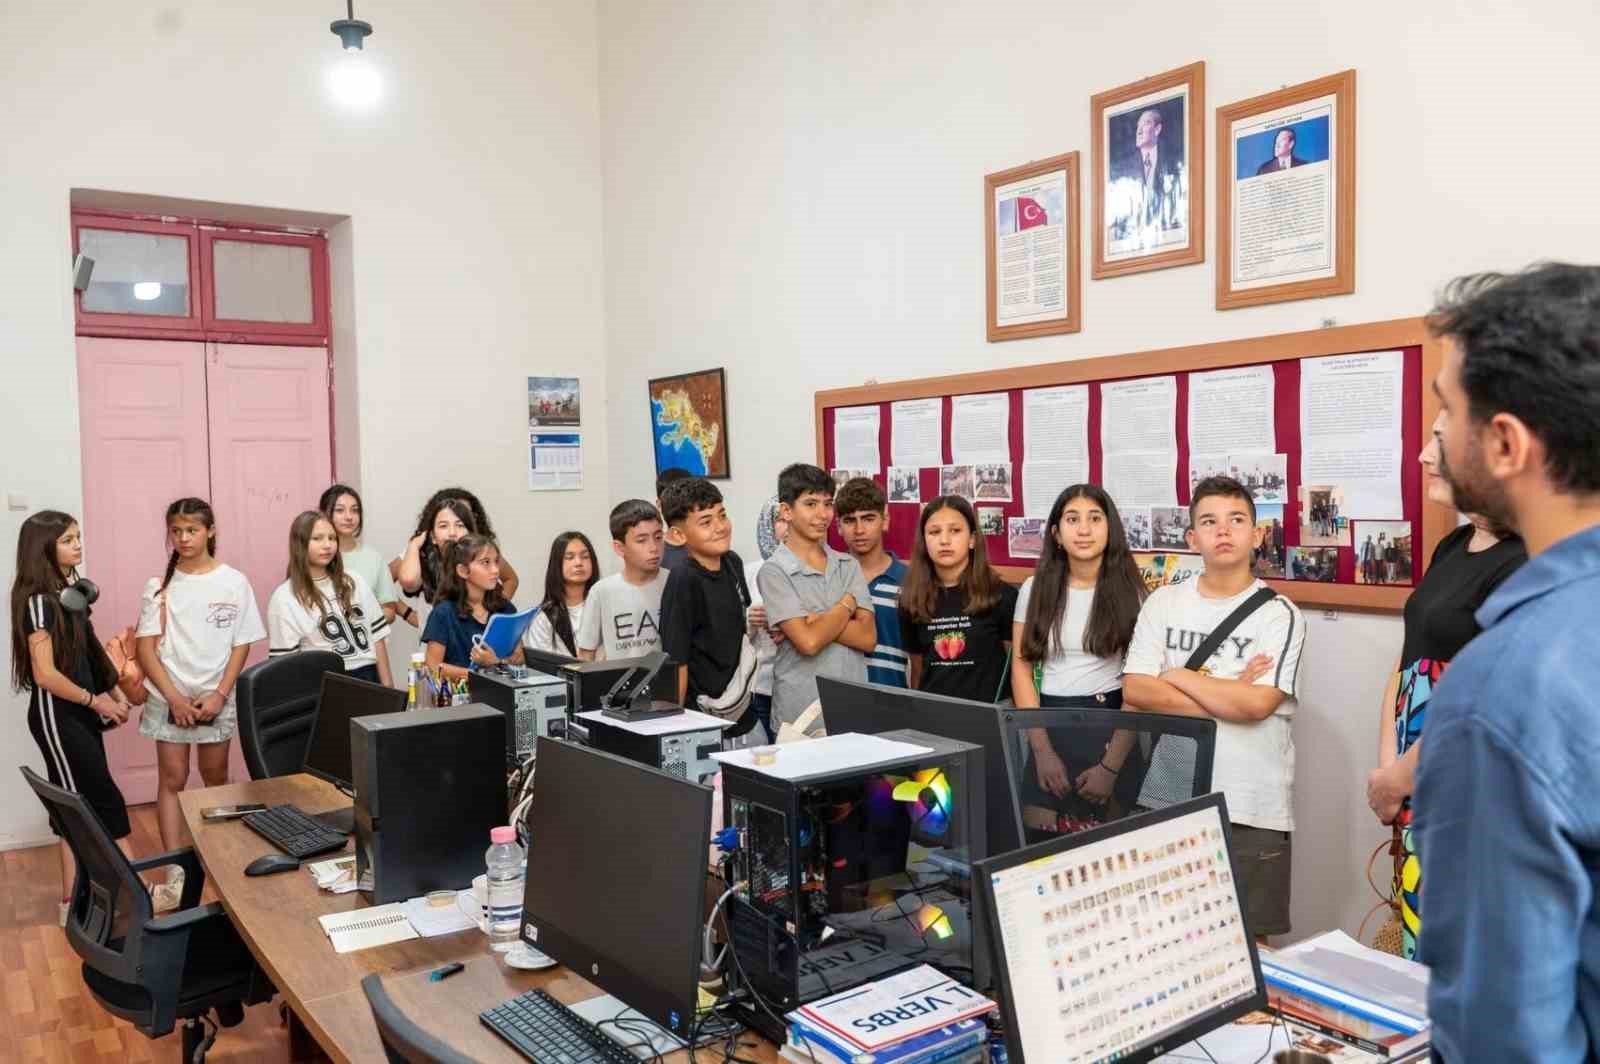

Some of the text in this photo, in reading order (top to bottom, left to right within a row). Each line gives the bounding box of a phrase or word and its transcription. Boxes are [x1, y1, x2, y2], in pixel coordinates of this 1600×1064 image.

[614, 610, 662, 639] EA
[1166, 627, 1252, 659] LUY
[852, 986, 973, 1033] L VERBS
